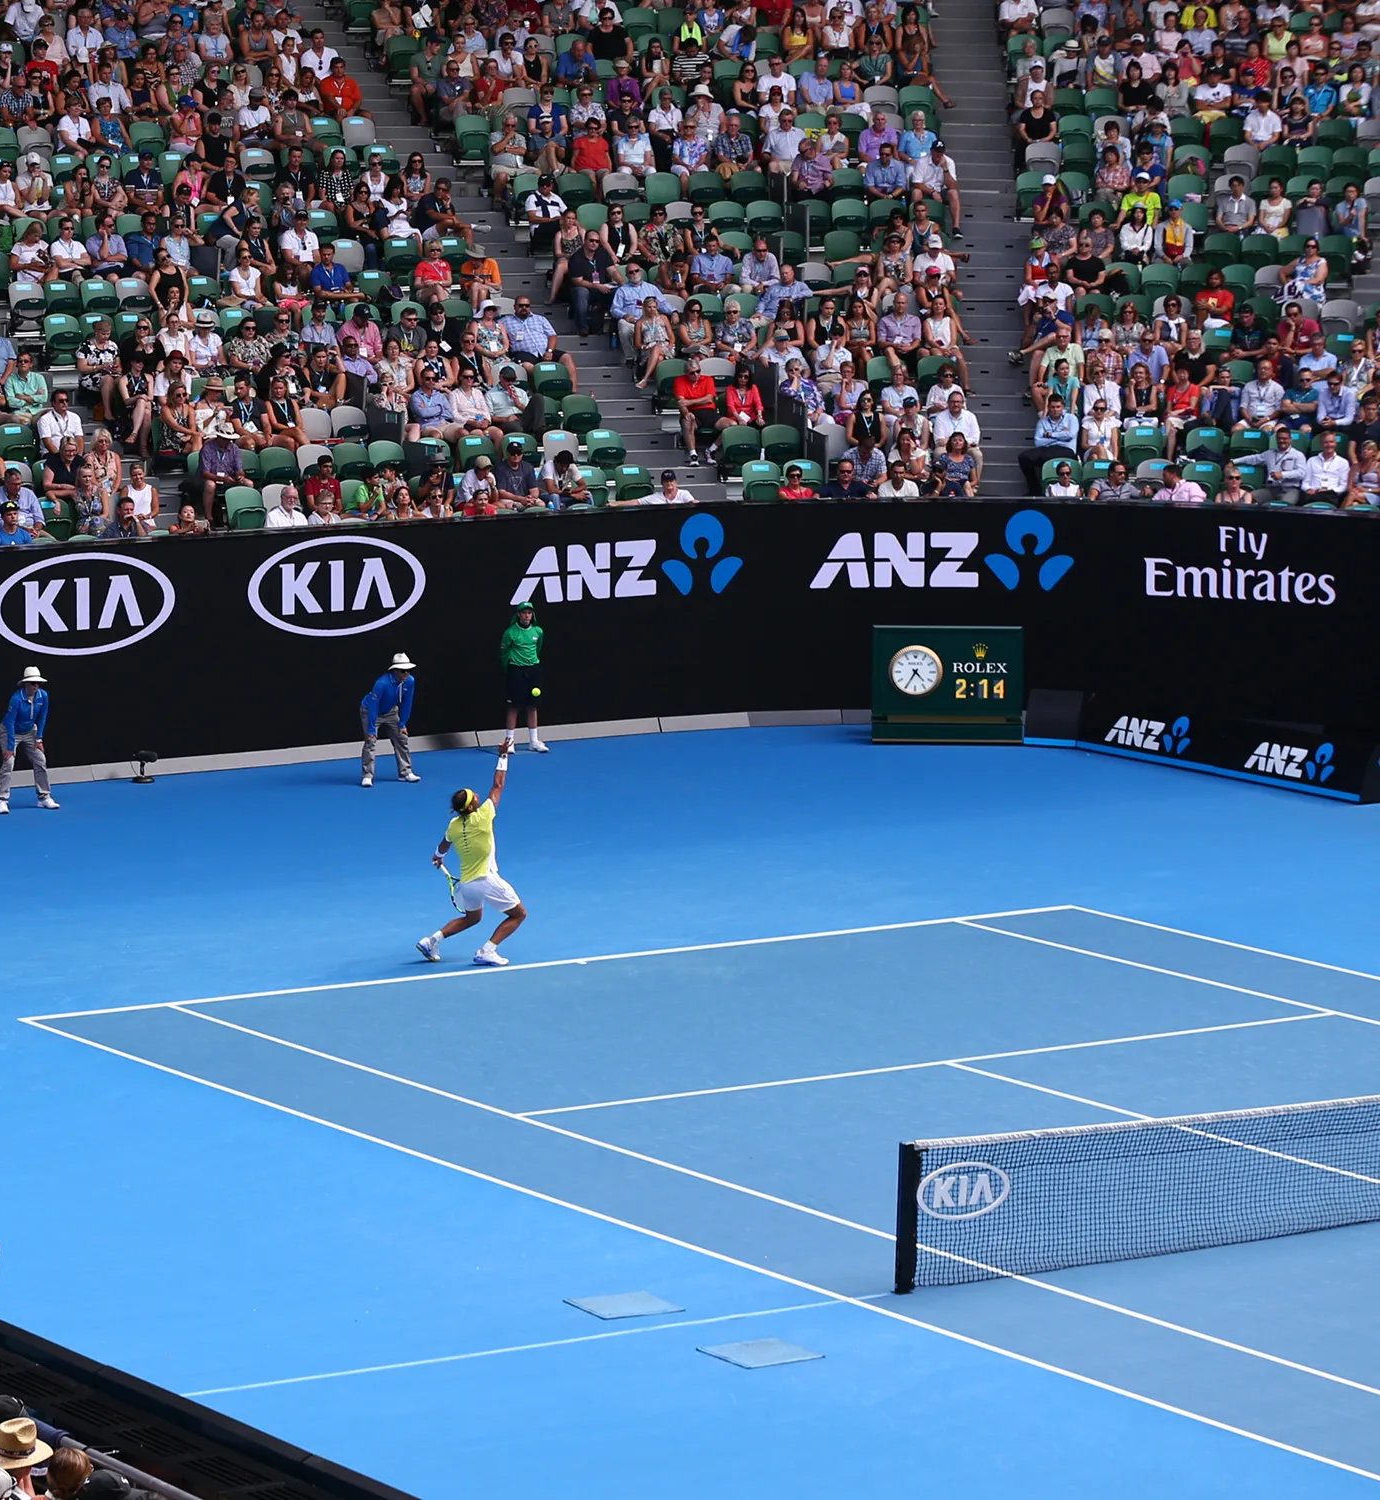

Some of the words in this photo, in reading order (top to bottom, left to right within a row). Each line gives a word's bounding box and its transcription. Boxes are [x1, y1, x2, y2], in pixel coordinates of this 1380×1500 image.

[809, 531, 979, 589] ANZ
[1219, 525, 1268, 560] Fly
[279, 556, 397, 615] KIA
[510, 539, 657, 605] ANZ
[1143, 557, 1337, 606] Emirates
[22, 574, 145, 634] KIA
[952, 662, 1008, 674] ROLEX
[955, 678, 1006, 699] 2:14
[1104, 715, 1166, 751] ANZ
[1244, 741, 1309, 779] ANZ
[933, 1174, 994, 1208] KIA
